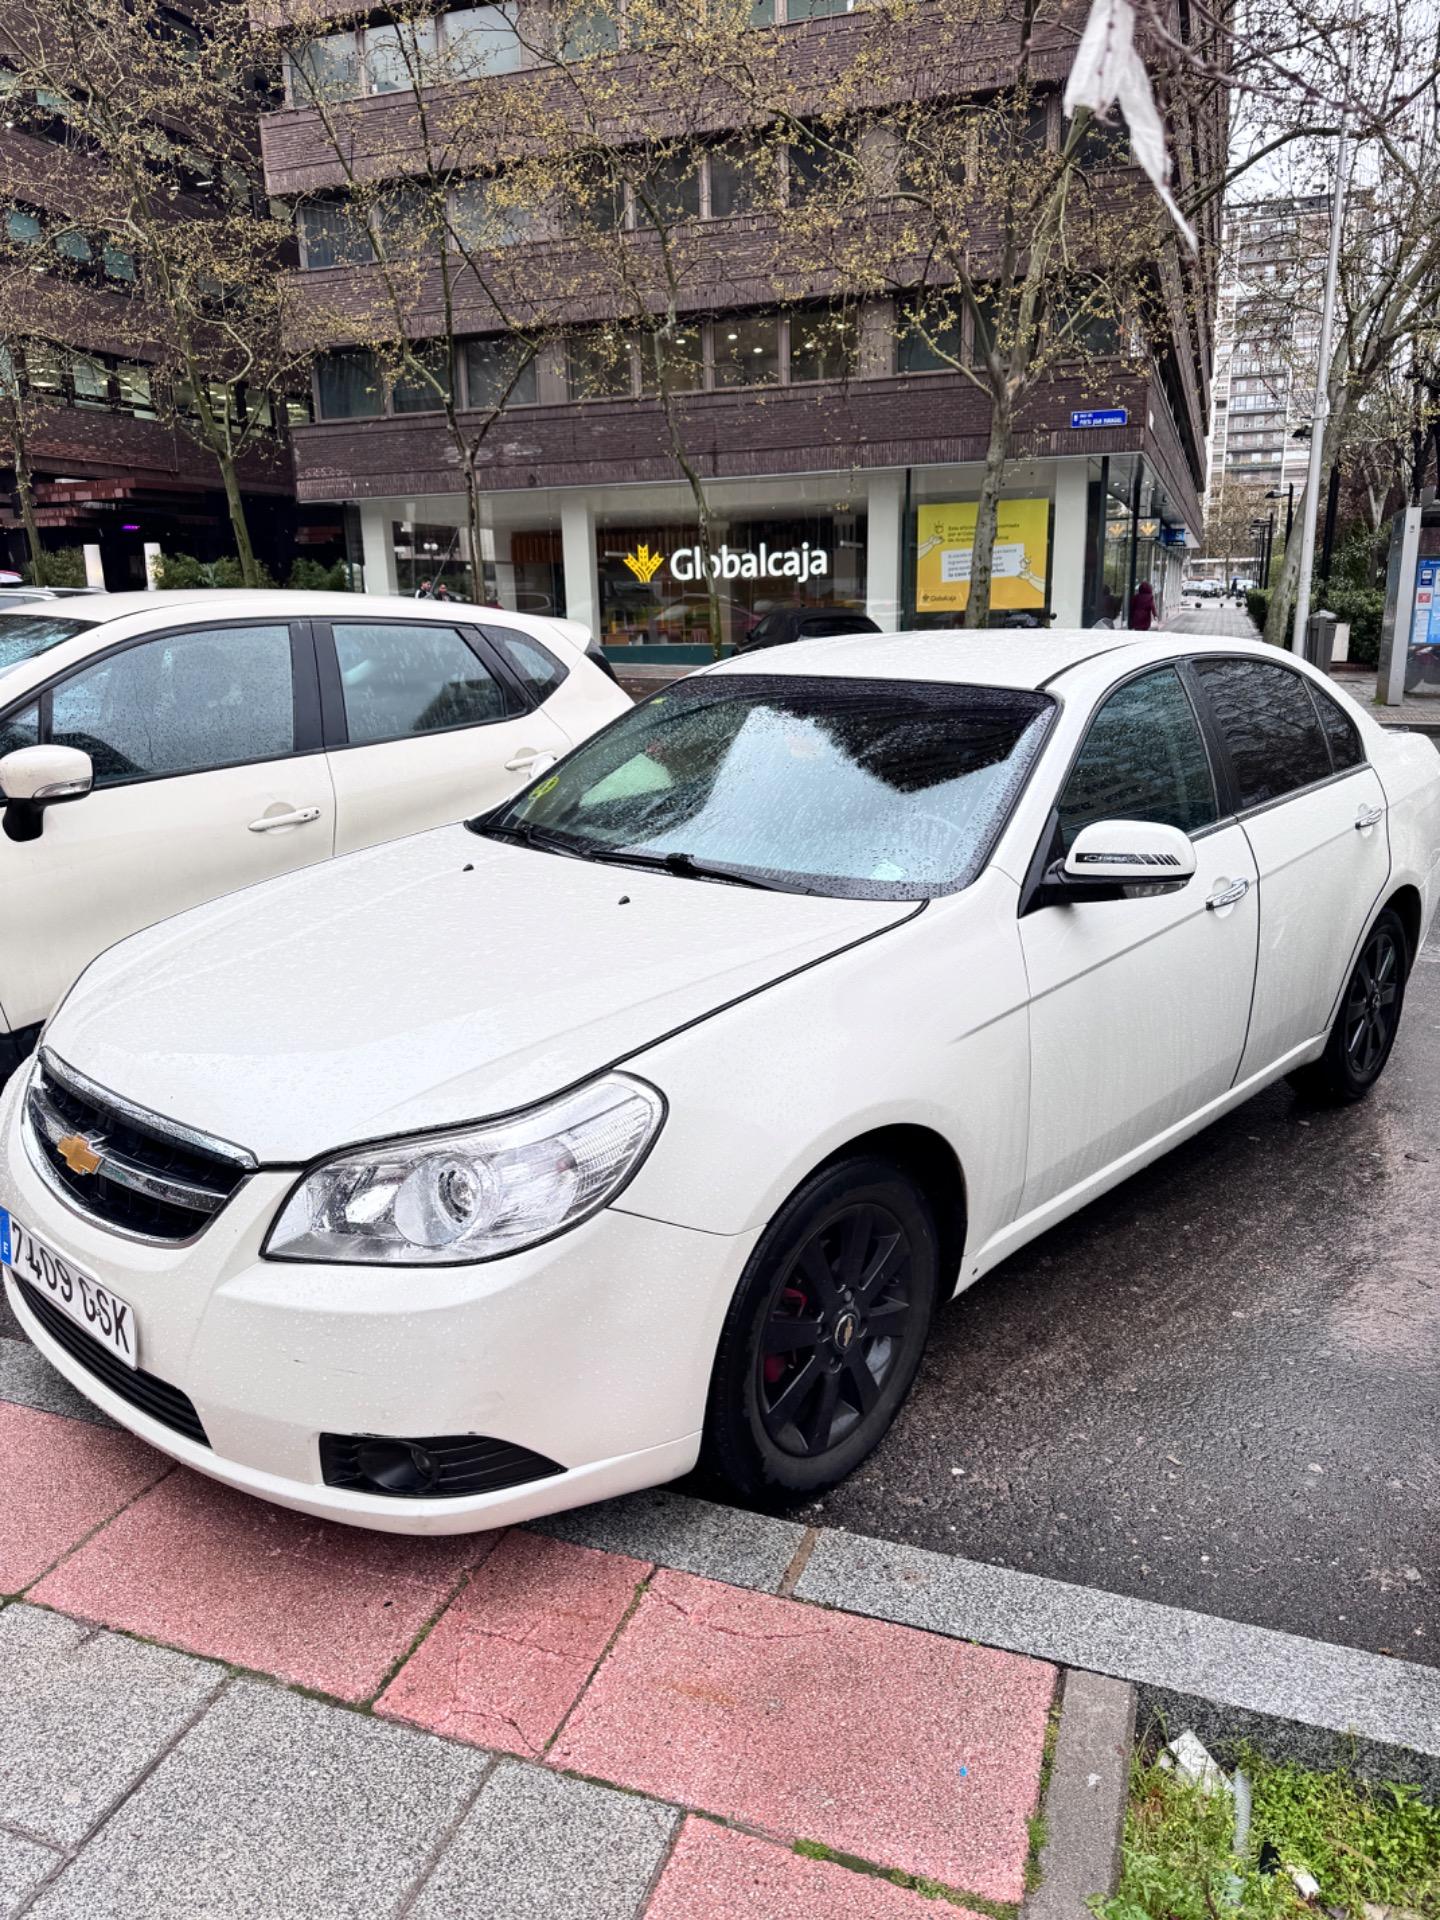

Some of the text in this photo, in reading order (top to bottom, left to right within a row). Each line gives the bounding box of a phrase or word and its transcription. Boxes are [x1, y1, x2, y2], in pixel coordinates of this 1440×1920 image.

[670, 541, 828, 583] Globalcaja
[11, 1221, 130, 1354] 7409 GSK
